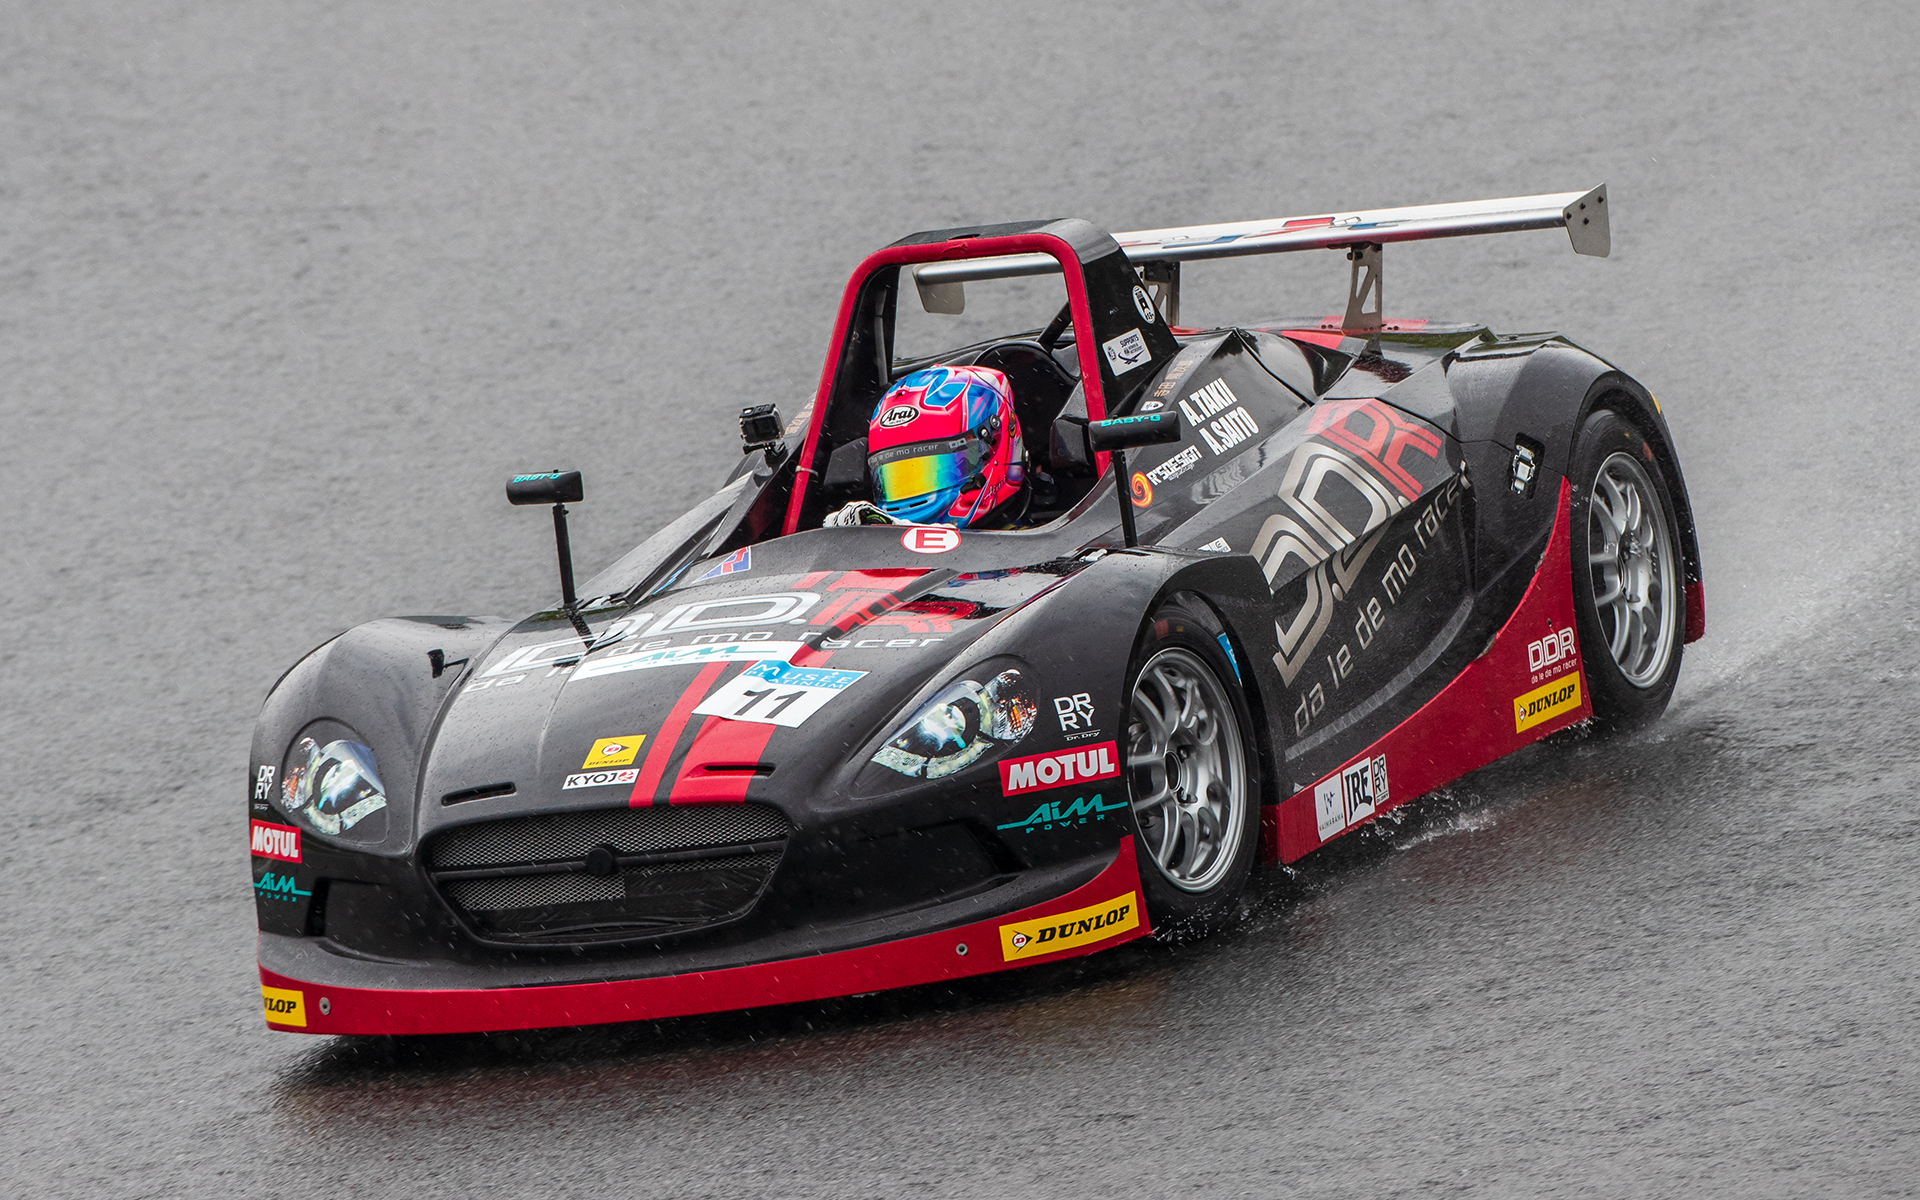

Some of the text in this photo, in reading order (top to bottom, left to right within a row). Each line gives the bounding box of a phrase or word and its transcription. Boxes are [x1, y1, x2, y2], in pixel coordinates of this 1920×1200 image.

[883, 407, 914, 422] Arai
[1100, 414, 1161, 427] BABY-G
[1198, 406, 1260, 456] A.SAITO
[913, 444, 940, 454] racer
[915, 529, 948, 549] E
[606, 639, 671, 657] de
[690, 631, 774, 646] mo
[798, 630, 944, 650] racer
[1294, 682, 1326, 738] da
[1326, 643, 1356, 690] le
[1355, 596, 1387, 649] de
[1381, 542, 1418, 605] mo
[1563, 658, 1578, 671] racer
[746, 669, 844, 690] PLATINUM
[733, 688, 808, 719] 11
[1528, 683, 1576, 717] DUNLOP
[1008, 747, 1116, 791] MOTUL
[1025, 814, 1105, 834] POWER
[251, 825, 299, 859] MOTUL
[1035, 904, 1130, 944] DUNLOP
